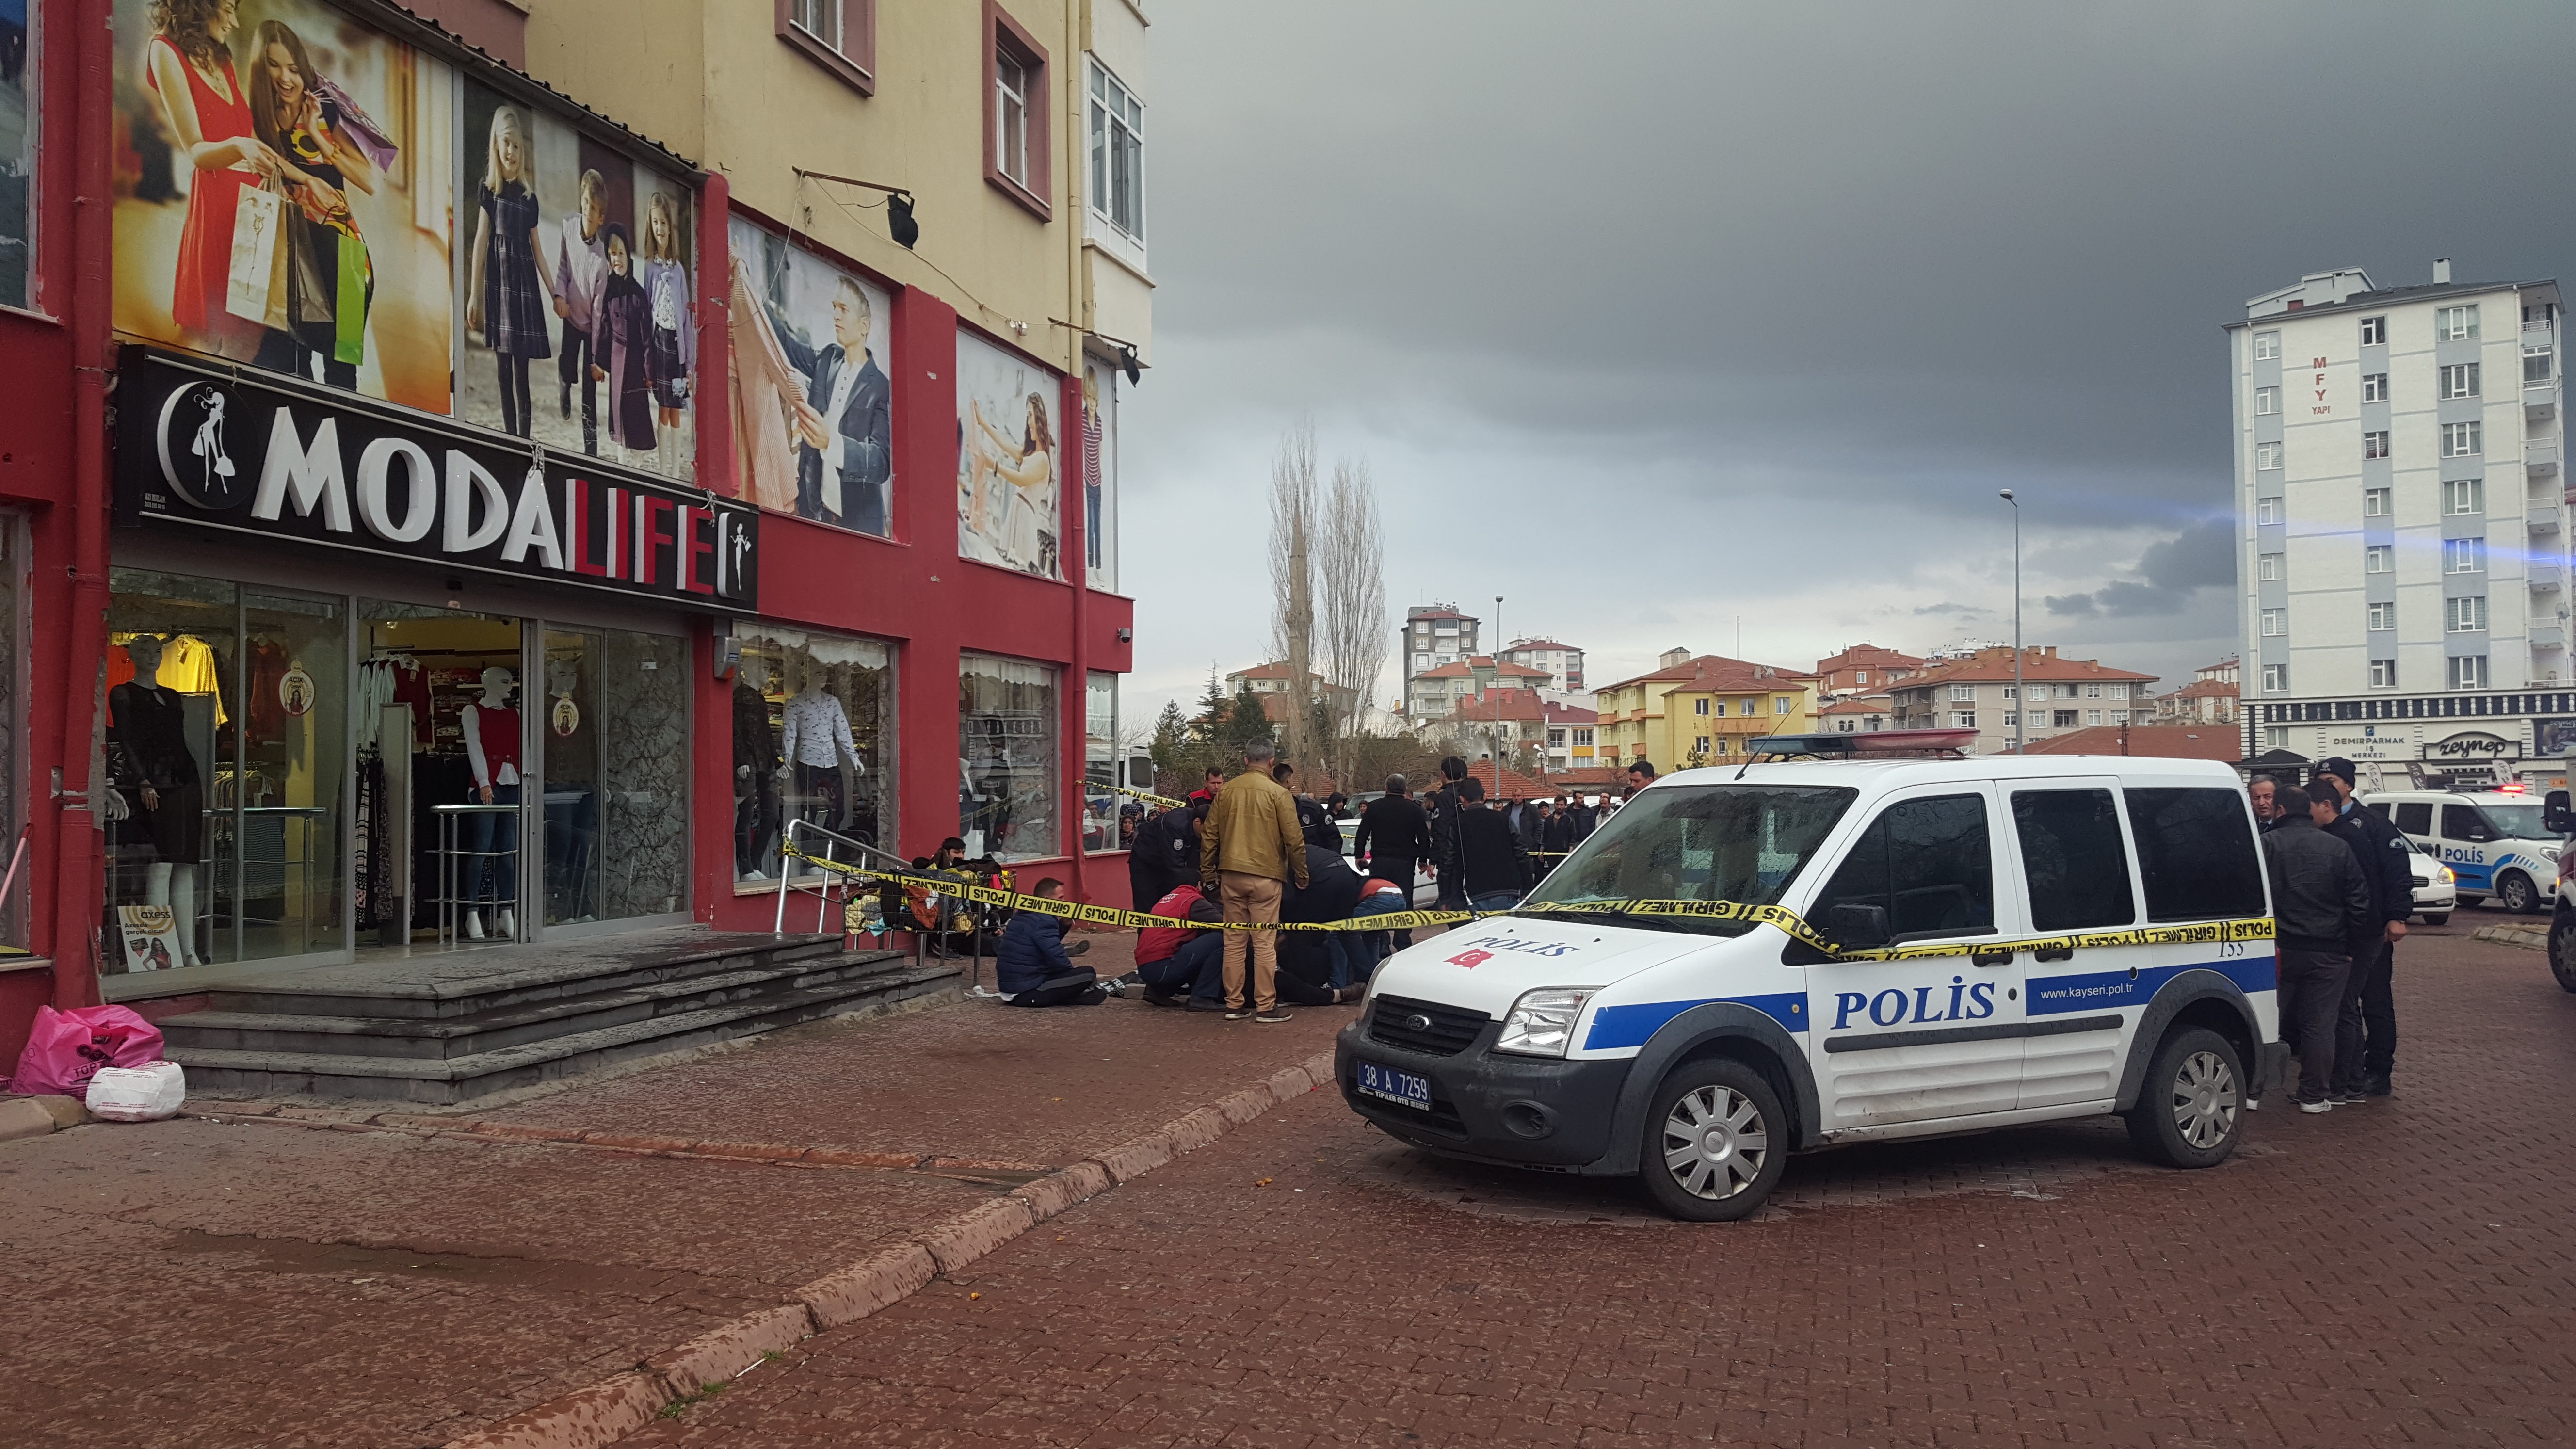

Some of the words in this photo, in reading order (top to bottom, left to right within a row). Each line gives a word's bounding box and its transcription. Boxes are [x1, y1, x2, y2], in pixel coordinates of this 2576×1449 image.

[2312, 406, 2330, 415] YAPI
[2439, 739, 2505, 757] zeynep
[2445, 846, 2484, 863] POLİS
[1459, 937, 1581, 957] POLİS
[2041, 983, 2134, 999] www.kayseri.pol.tr
[1830, 975, 1995, 1030] POLİS
[1365, 1064, 1377, 1087] 38
[1385, 1070, 1392, 1091] A
[1399, 1073, 1428, 1100] 7259
